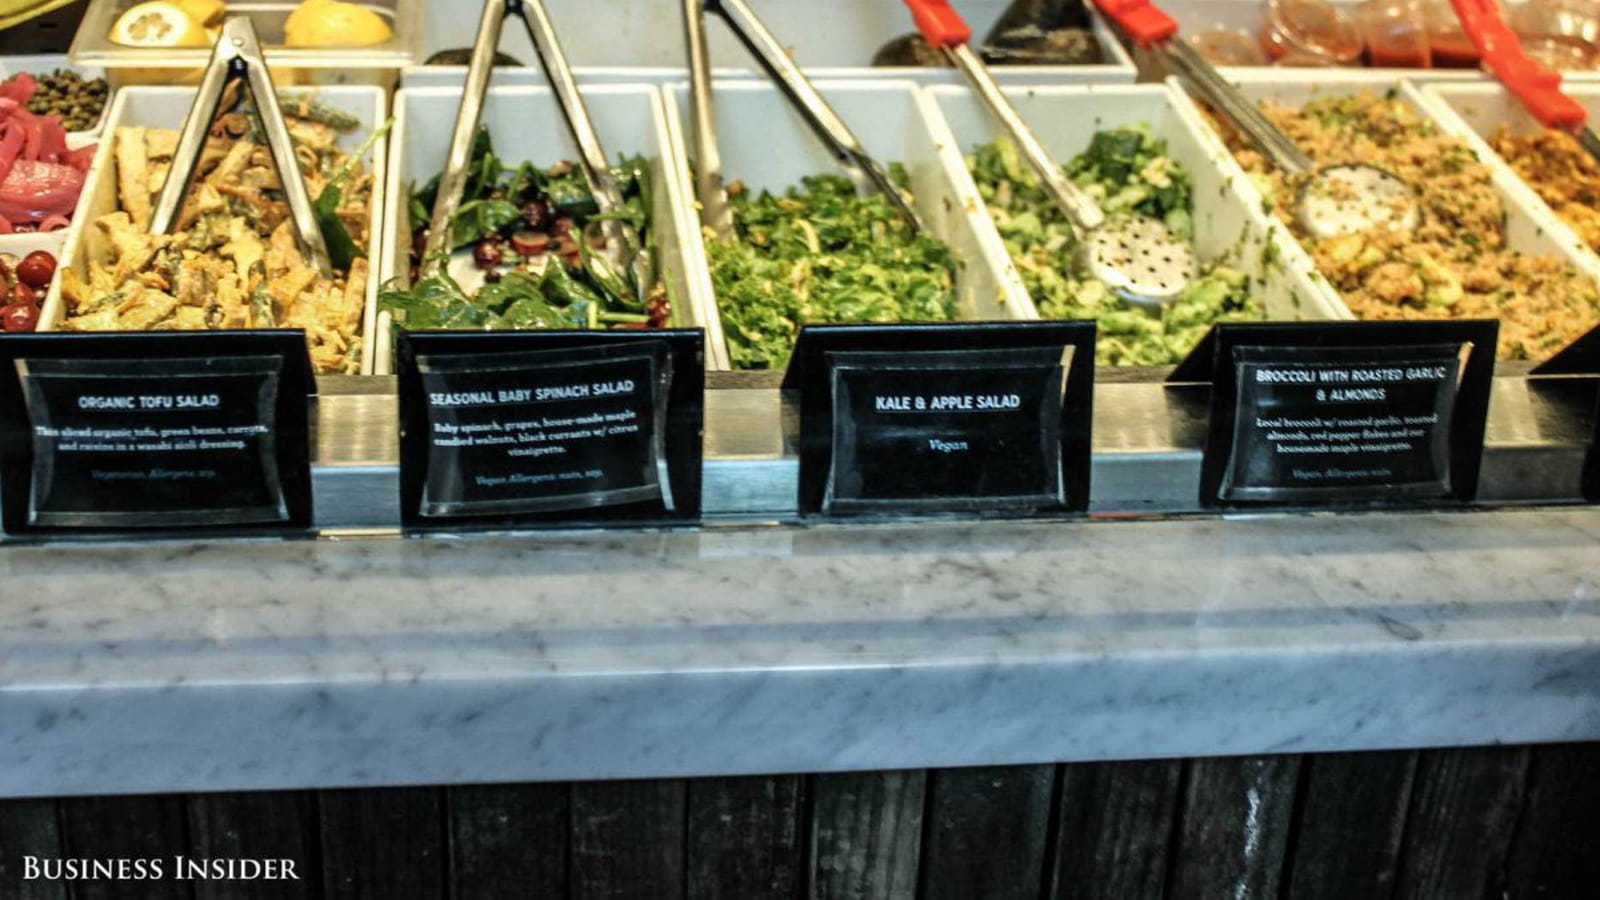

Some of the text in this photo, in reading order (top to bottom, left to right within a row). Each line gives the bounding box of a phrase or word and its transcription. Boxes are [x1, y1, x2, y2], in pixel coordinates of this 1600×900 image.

[1256, 367, 1446, 383] BROCCOLI WITH ROASTED GARLIC
[430, 380, 634, 405] SEASONAL BABY SPINACH SALAD
[1316, 388, 1386, 401] & ALMONDS
[78, 395, 219, 408] ORGANIC TOFU SALAD
[876, 394, 1020, 410] KALE & APPLE SALAD
[434, 422, 459, 434] Baby
[518, 431, 546, 443] black
[929, 439, 968, 452] Vegan
